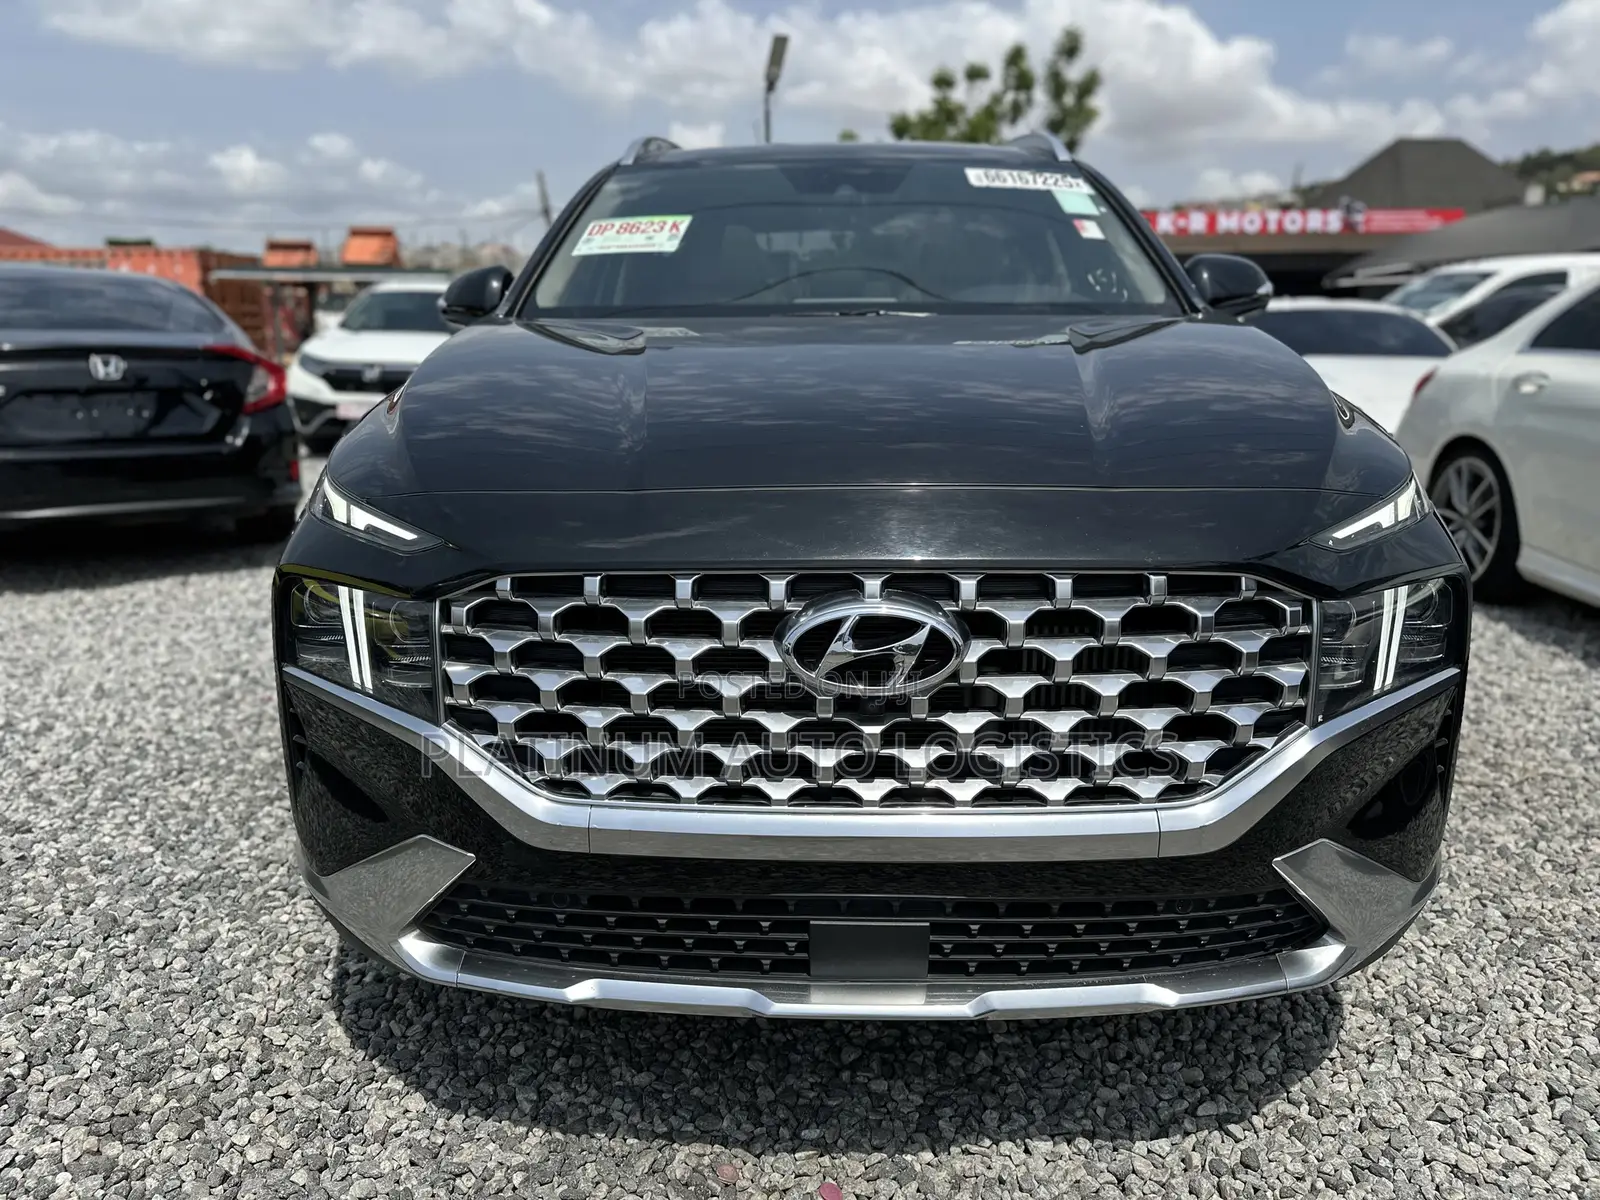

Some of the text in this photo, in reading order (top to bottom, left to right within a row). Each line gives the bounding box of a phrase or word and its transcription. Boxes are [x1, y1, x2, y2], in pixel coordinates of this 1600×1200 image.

[587, 222, 615, 237] DP
[669, 219, 686, 234] K
[1216, 208, 1344, 235] MOTORS
